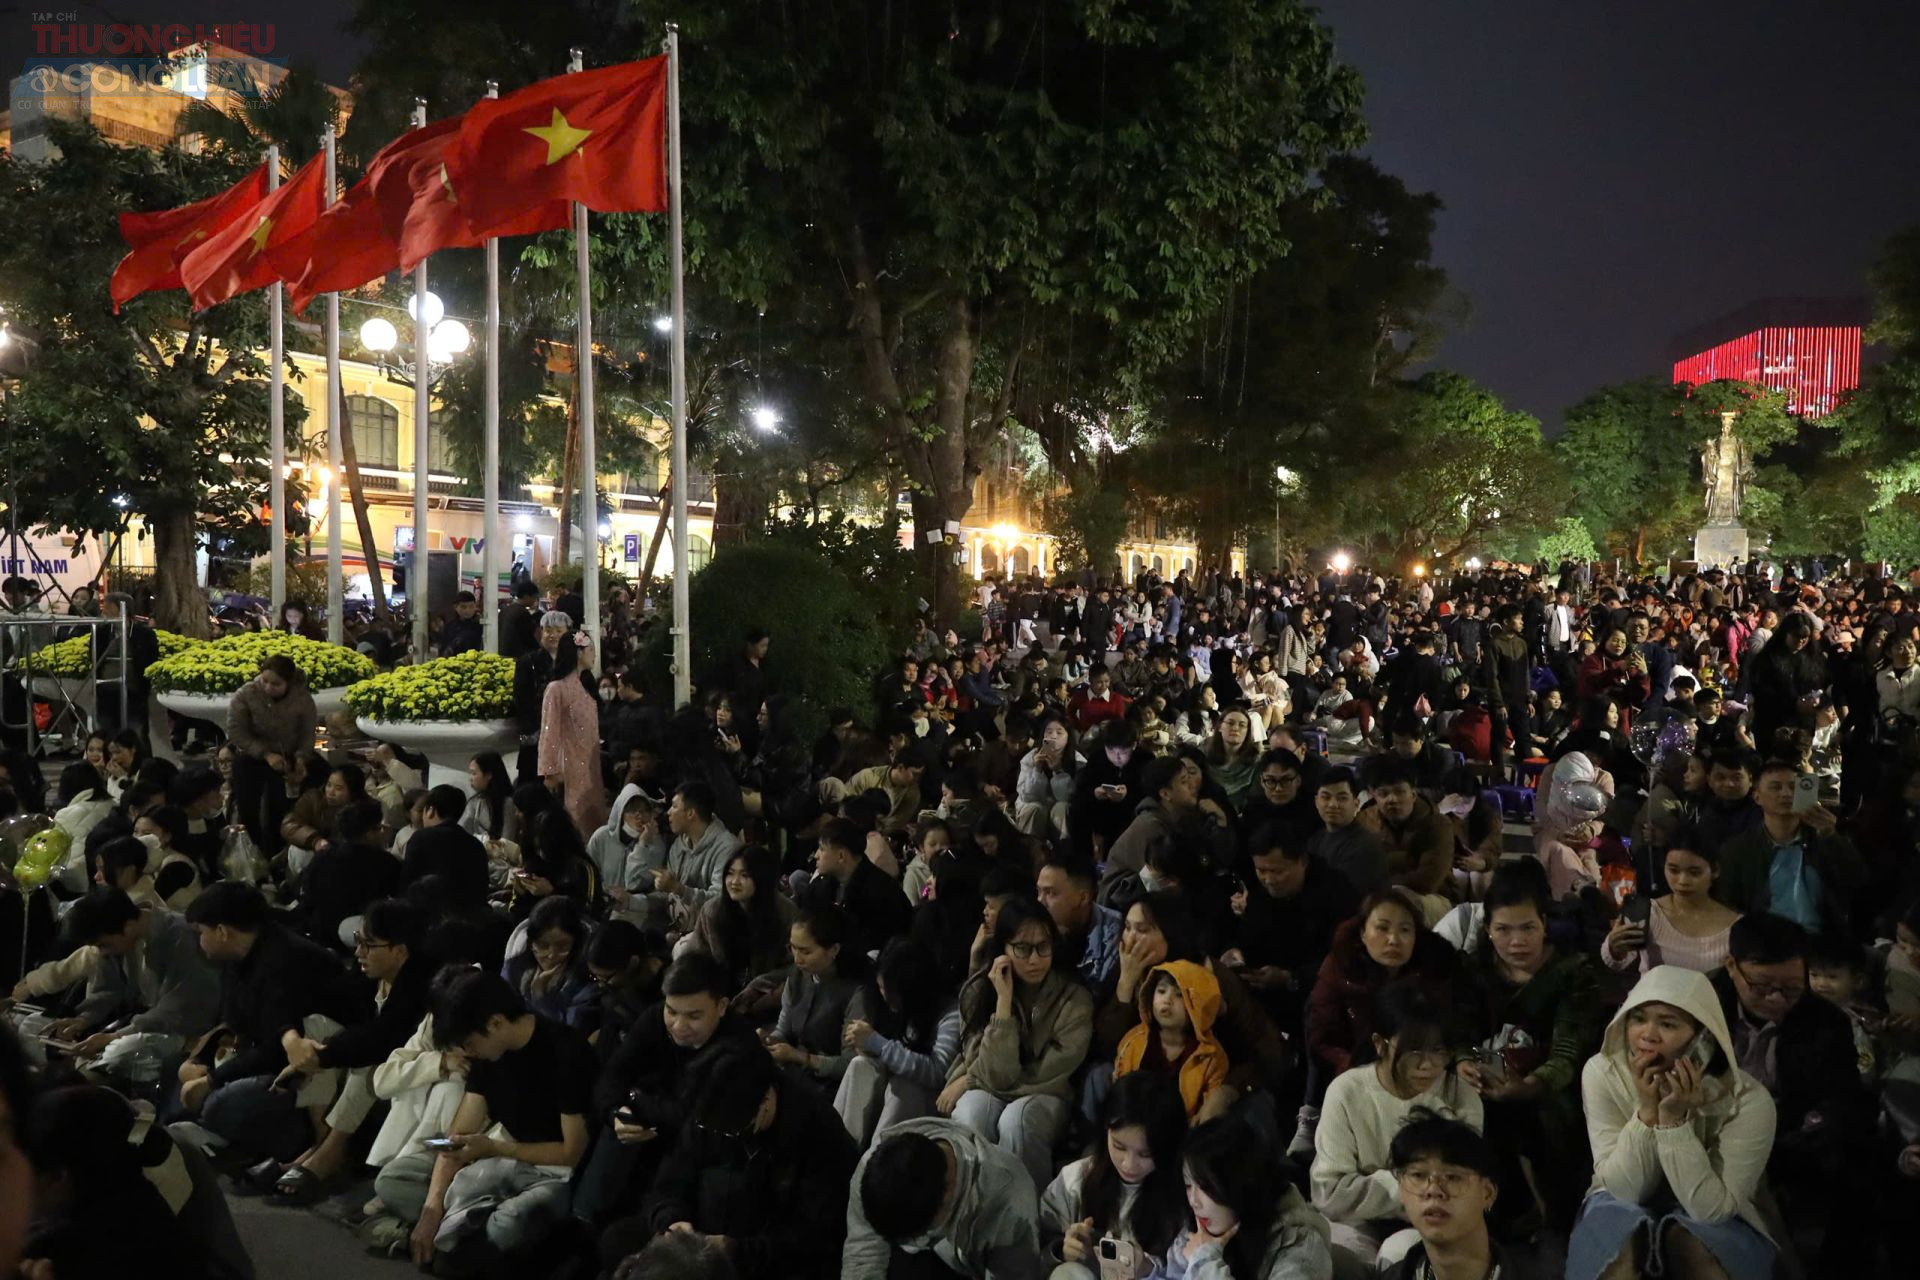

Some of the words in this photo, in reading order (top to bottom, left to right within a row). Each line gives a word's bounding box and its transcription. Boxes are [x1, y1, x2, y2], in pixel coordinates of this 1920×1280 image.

[450, 536, 485, 555] VTV
[627, 540, 635, 554] P
[31, 559, 68, 574] NAM
